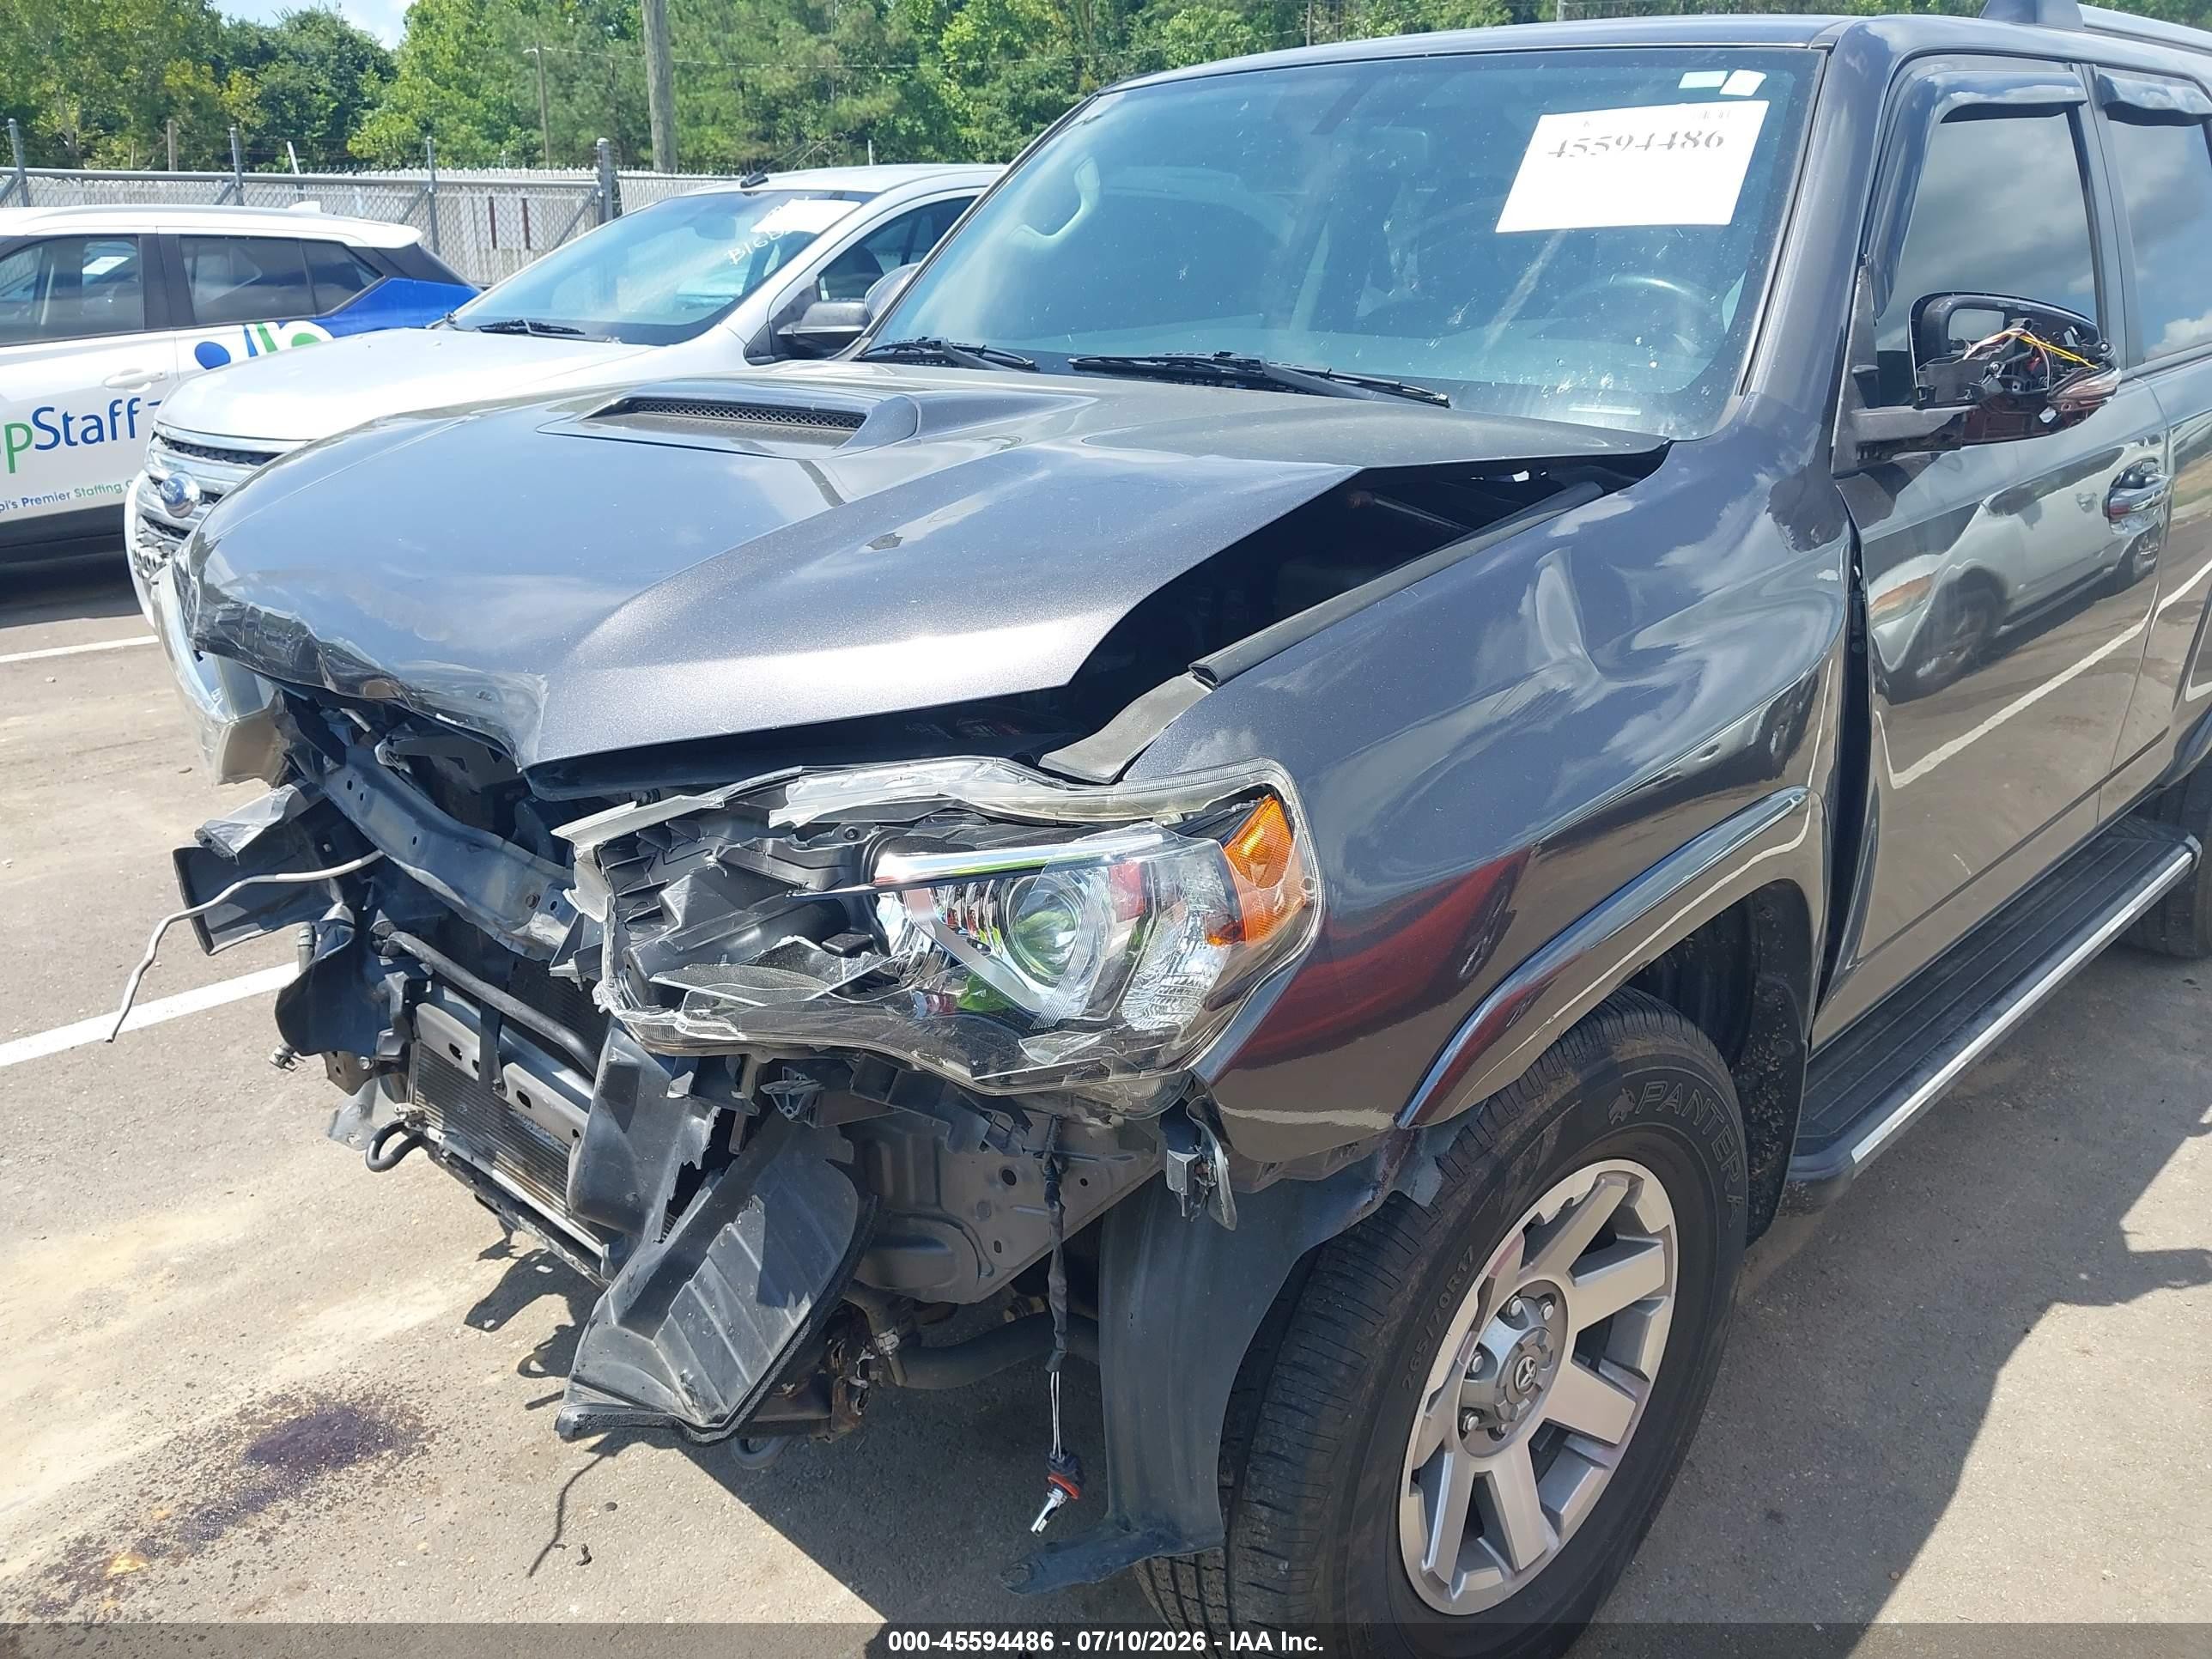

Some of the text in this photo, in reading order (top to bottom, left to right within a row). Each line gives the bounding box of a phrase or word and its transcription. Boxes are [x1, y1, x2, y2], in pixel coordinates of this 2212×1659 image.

[1547, 130, 1724, 158] 45594486
[3, 397, 141, 474] pStaff
[21, 491, 70, 507] Premier
[74, 482, 122, 498] Staffing
[1401, 1246, 1474, 1389] 265/70R17
